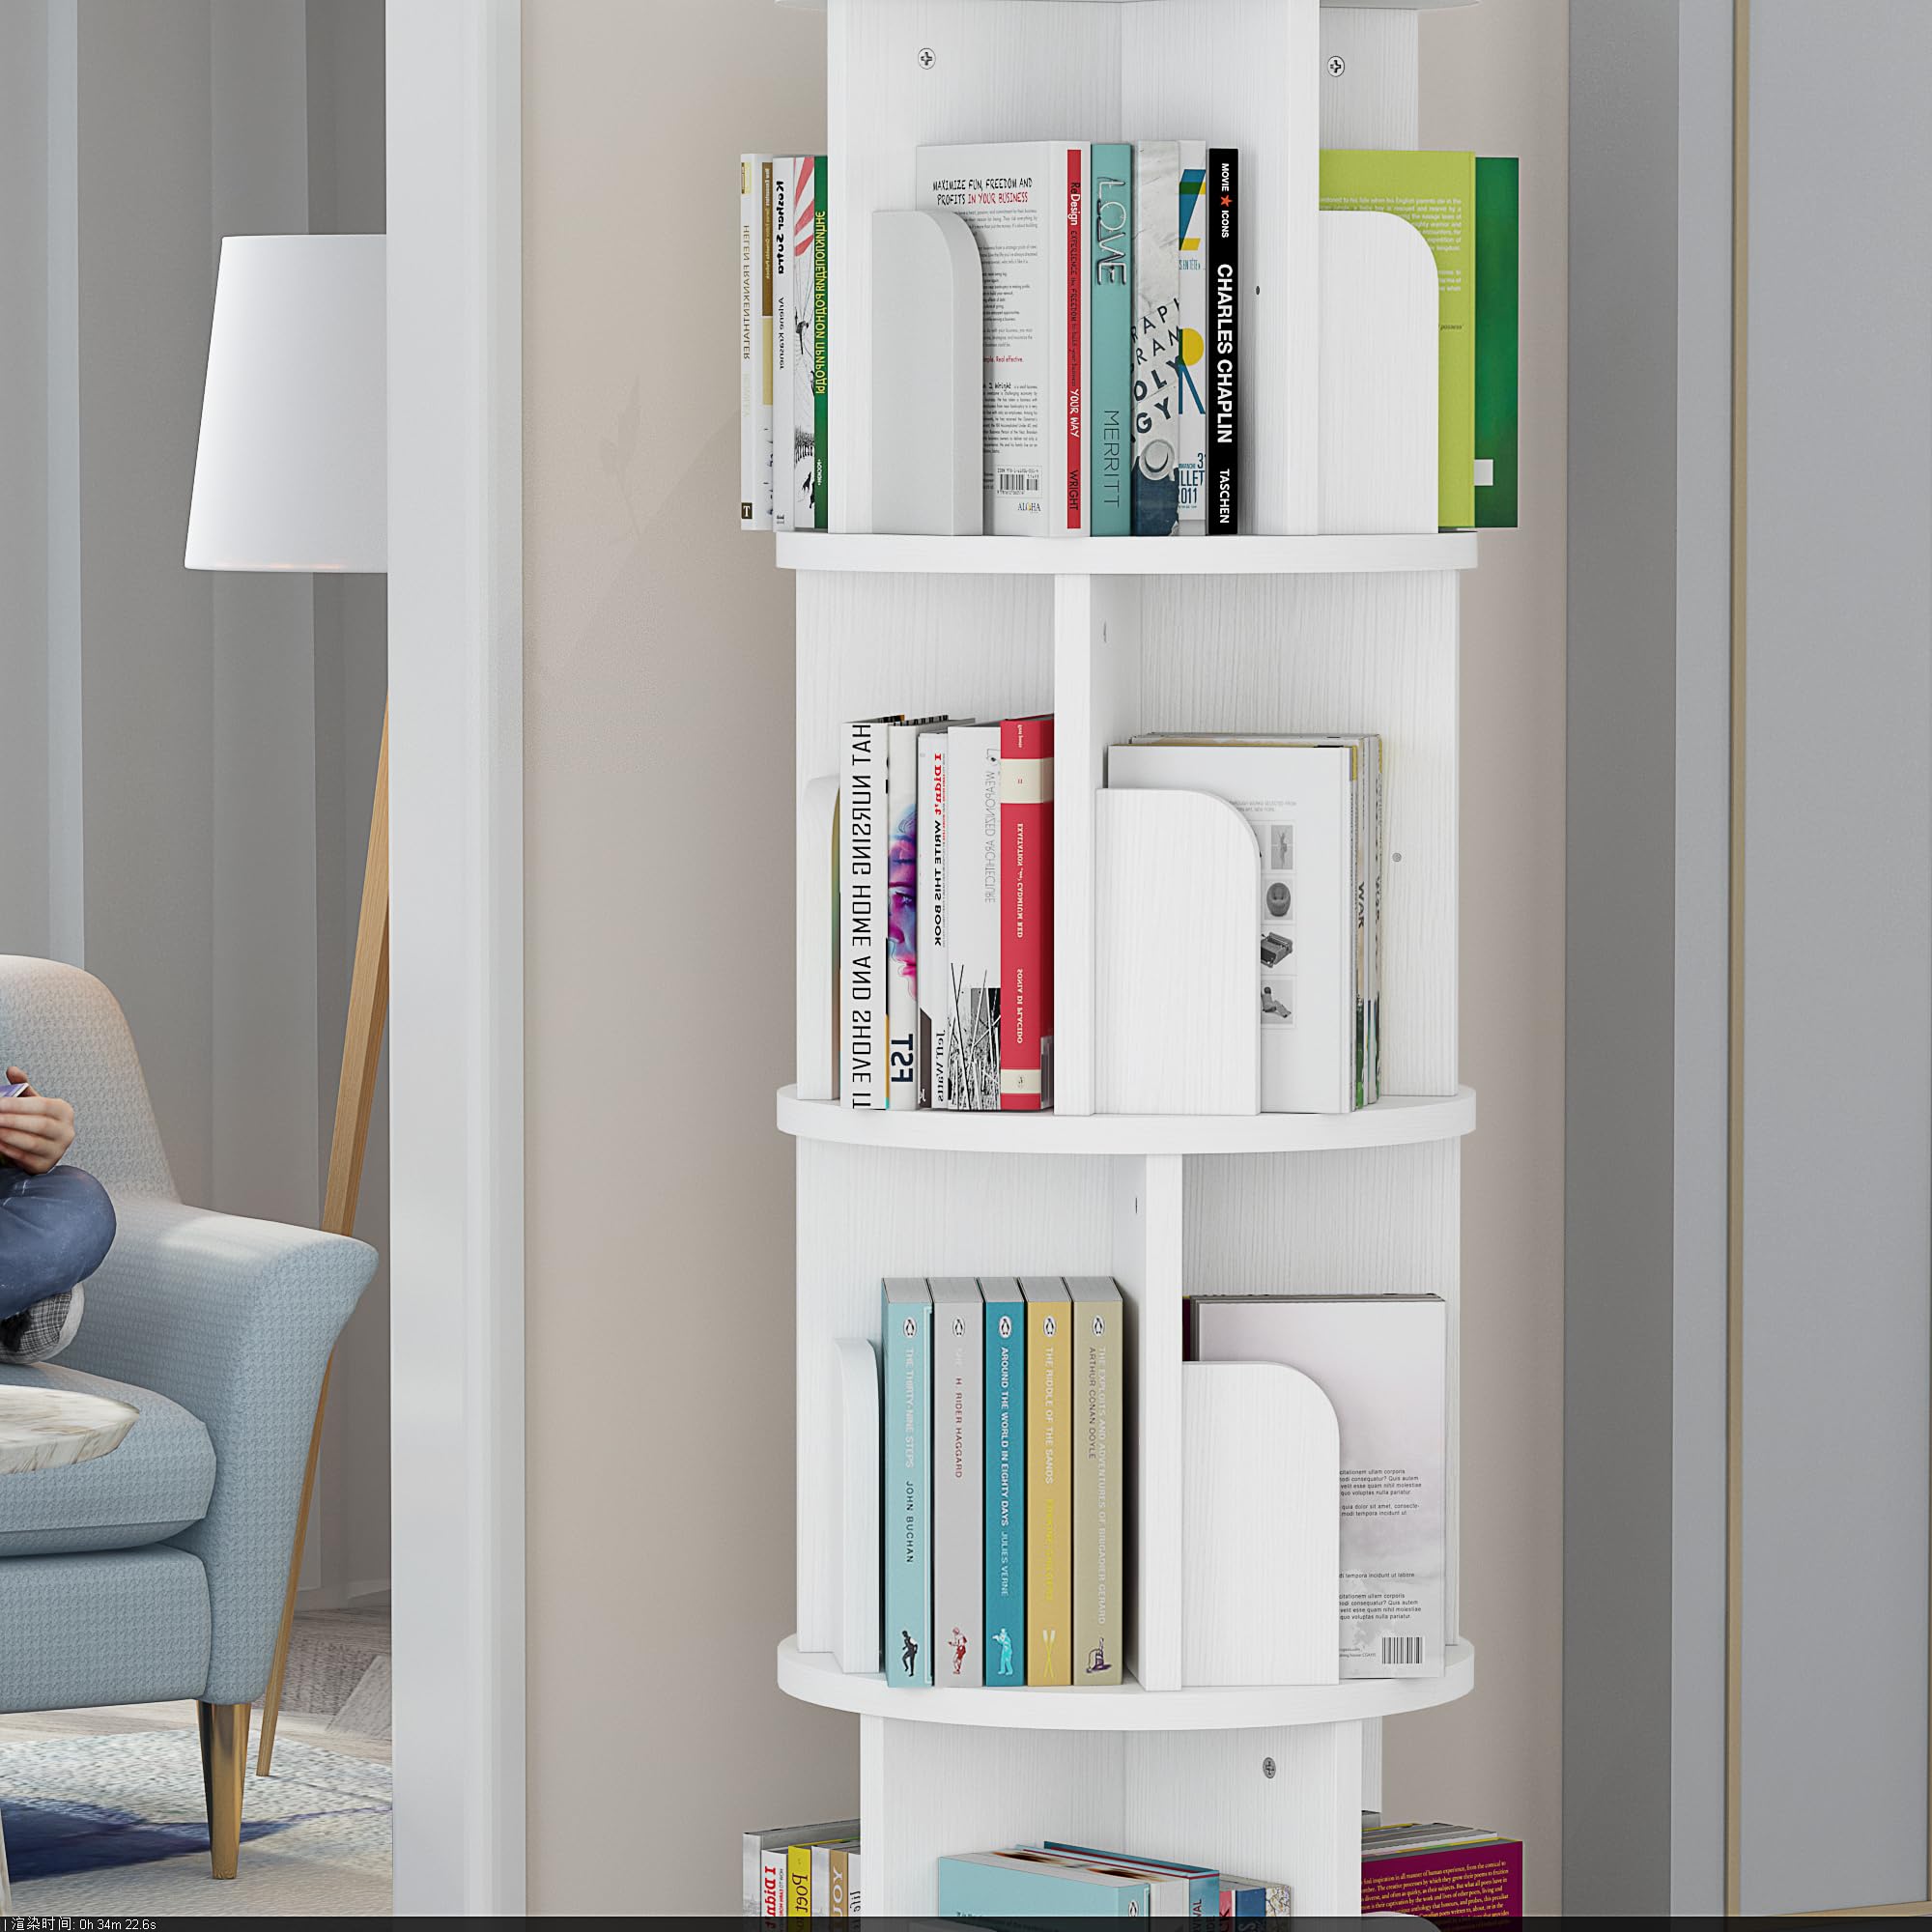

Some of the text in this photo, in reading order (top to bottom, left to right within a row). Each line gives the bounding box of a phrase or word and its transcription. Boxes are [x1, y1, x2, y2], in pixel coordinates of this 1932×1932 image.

[932, 177, 1033, 192] MAXIMIZE FUN, FREEDOM AND
[937, 191, 1029, 206] PROFITS IN YOUR BUSINESS
[1067, 182, 1080, 225] ReDesign
[1221, 162, 1230, 238] MOVIE ICONS
[1096, 180, 1126, 286] LOVE
[1217, 264, 1233, 443] CHARLES CHAPLIN
[1069, 388, 1079, 413] YOUR
[1069, 416, 1079, 438] WAY
[1103, 411, 1120, 509] MERRITT
[1068, 469, 1079, 510] WRIGHT
[1219, 469, 1230, 524] TASCHEN
[1097, 1369, 1106, 1416] EXPLOITS
[1045, 1409, 1053, 1423] OF
[1097, 1419, 1106, 1440] AND
[1001, 1450, 1009, 1461] IN
[1097, 1443, 1106, 1508] ADVENTURES
[905, 1481, 914, 1563] JOHN BUCHAN
[1097, 1527, 1106, 1580] BRIGADIER
